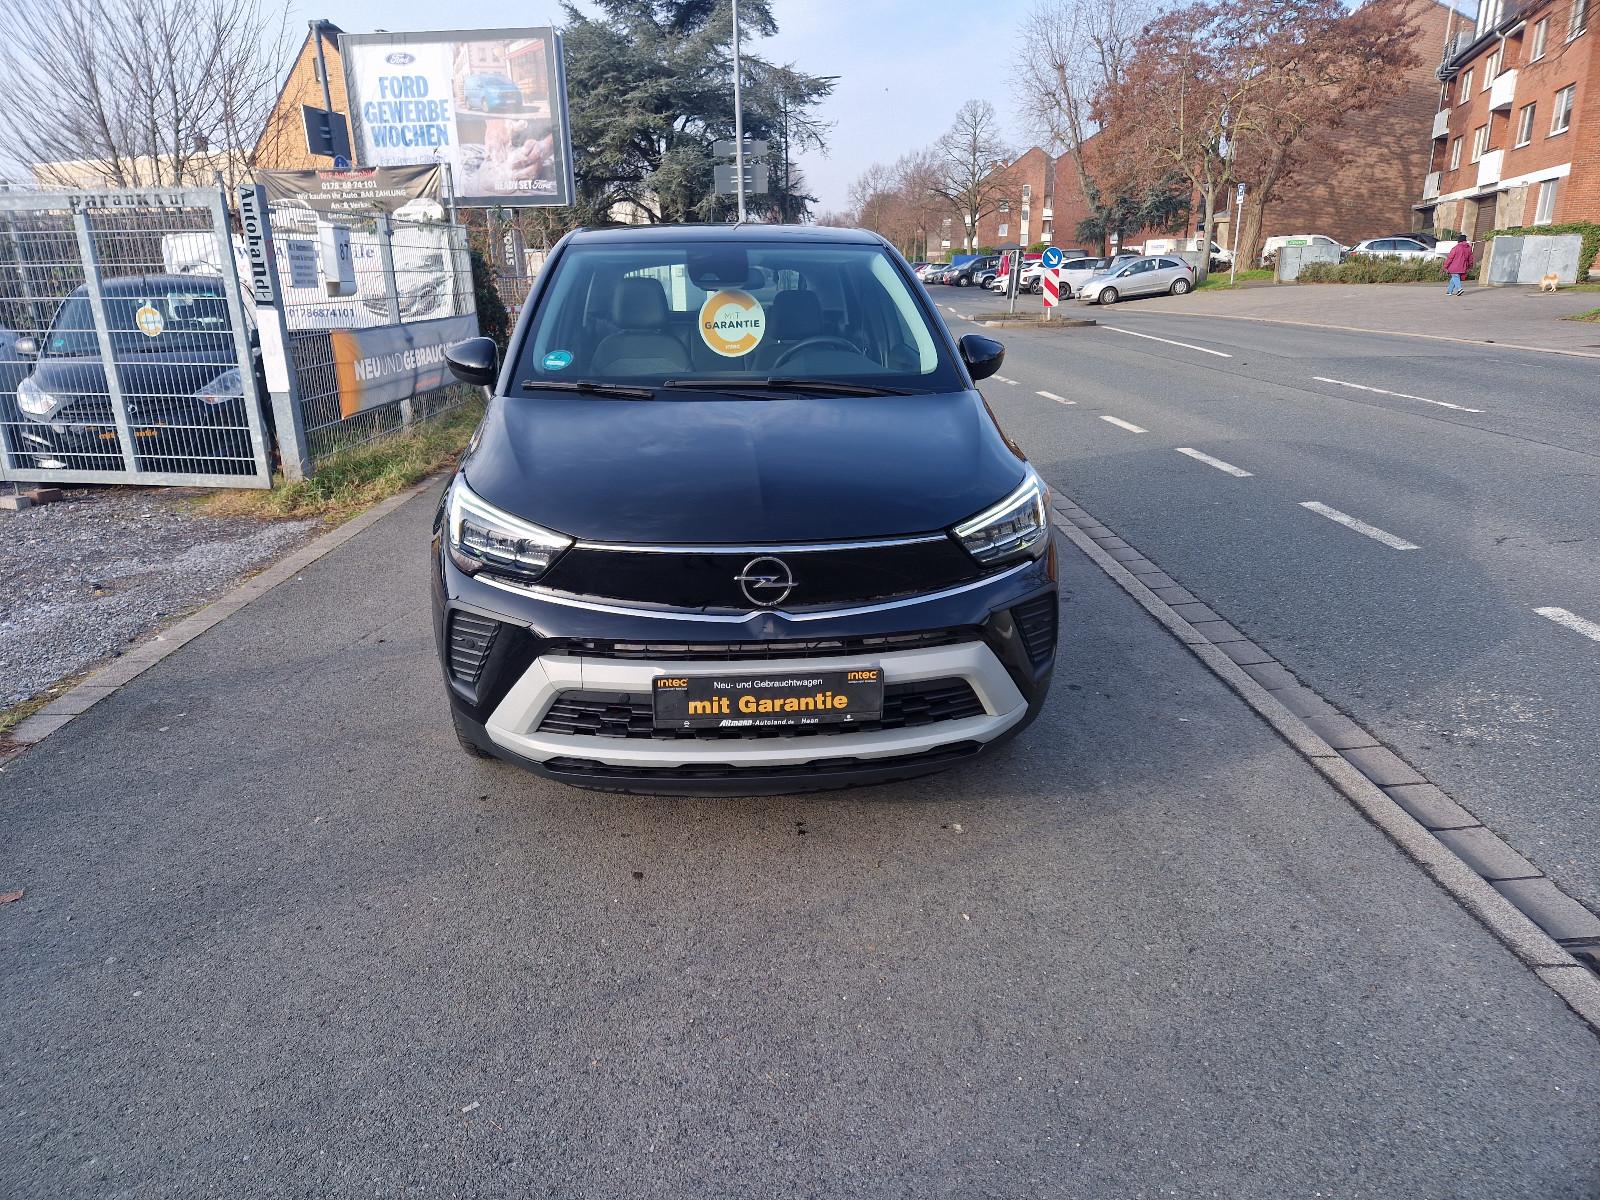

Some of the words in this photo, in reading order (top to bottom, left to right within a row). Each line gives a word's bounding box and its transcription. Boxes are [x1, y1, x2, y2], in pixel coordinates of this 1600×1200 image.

[378, 75, 429, 99] FORD
[363, 99, 450, 124] GEWERBE
[370, 124, 449, 147] WOCHEN
[518, 179, 532, 190] SET
[340, 243, 349, 260] 87
[704, 319, 760, 330] GARANTIE
[657, 678, 688, 687] intec
[847, 670, 878, 681] intec
[713, 681, 734, 689] Neu-
[736, 680, 752, 689] und
[754, 678, 823, 690] Gebrauchtwagen
[688, 696, 731, 715] mit
[738, 691, 848, 714] Garantie
